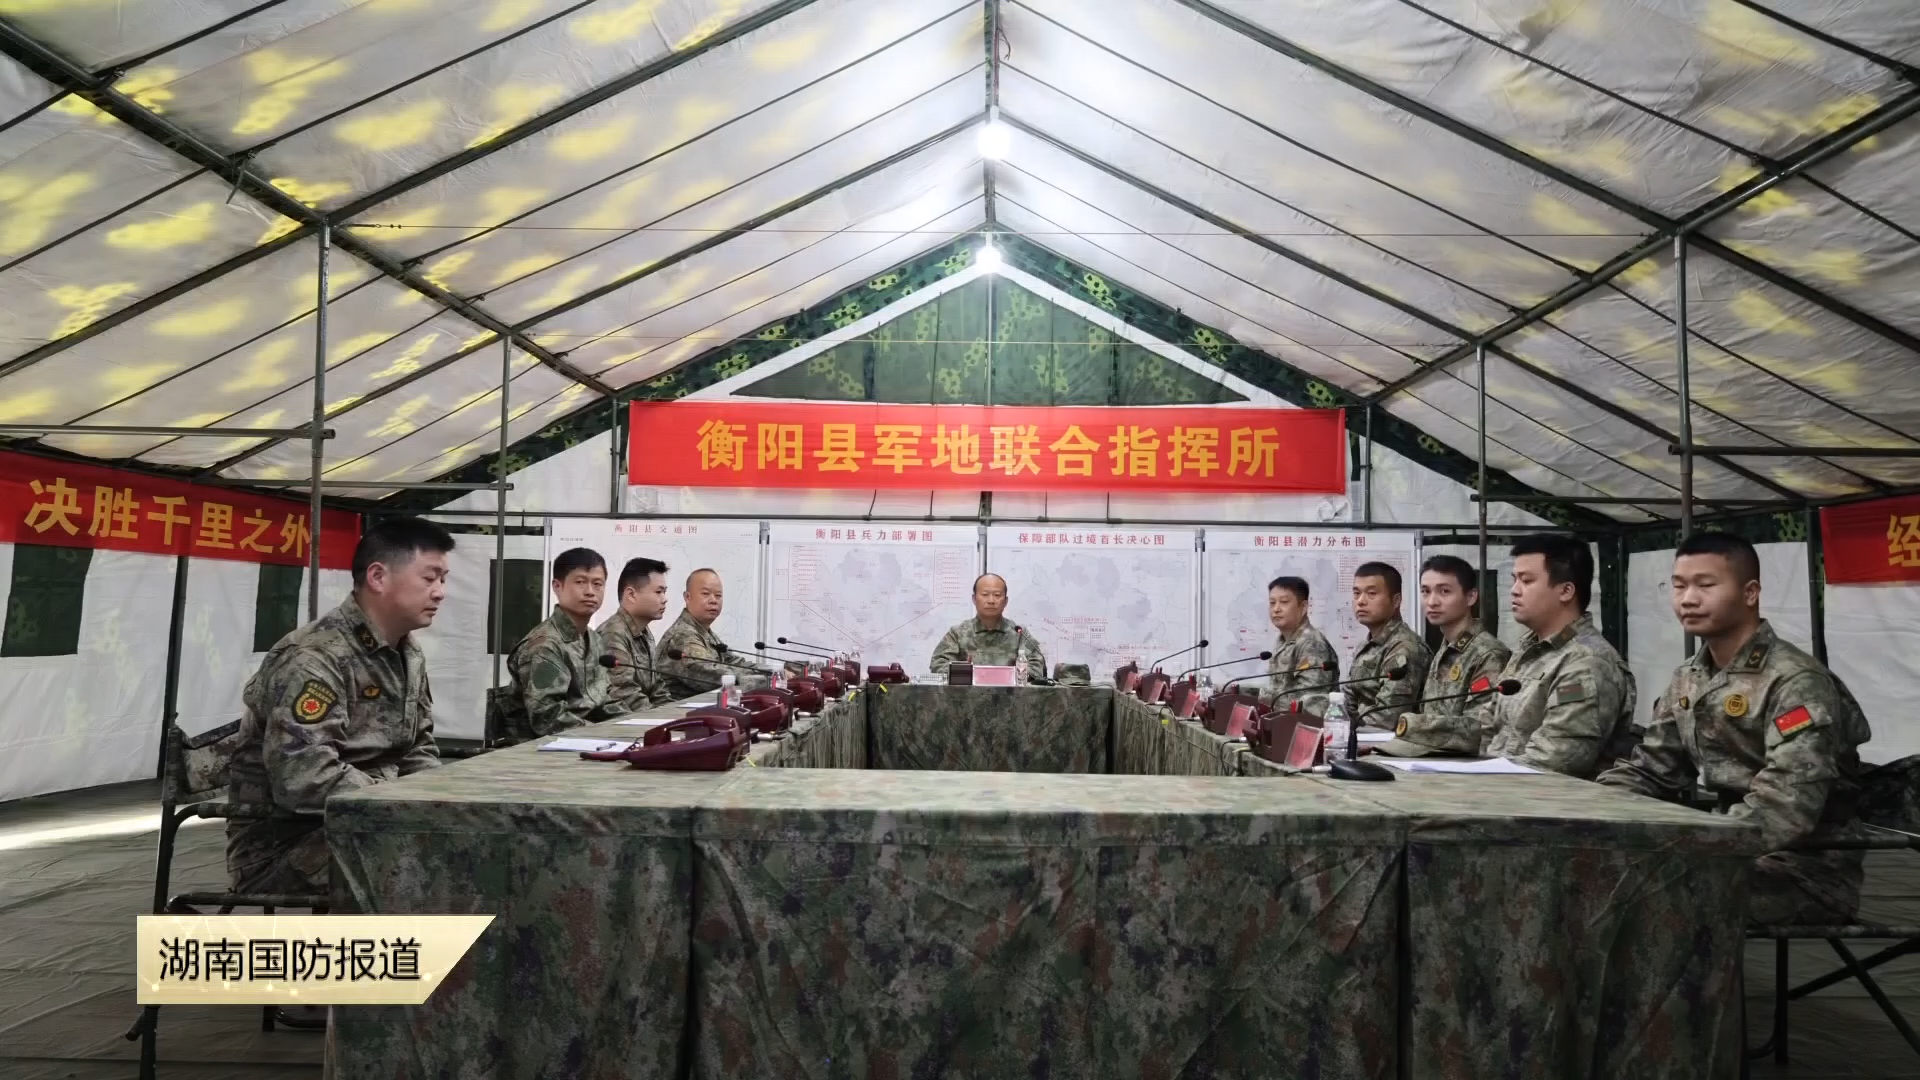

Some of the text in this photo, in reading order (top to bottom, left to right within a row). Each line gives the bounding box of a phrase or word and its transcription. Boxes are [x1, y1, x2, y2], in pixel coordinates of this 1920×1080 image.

[697, 420, 1279, 478] 衡阳县军地联合指挥所
[24, 477, 310, 558] 决胜千里之外
[815, 528, 933, 542] 衡阳县兵力部署图
[1018, 532, 1165, 545] 保障部队过境首长决心图
[1254, 535, 1366, 547] 衡阳县潜力分布图
